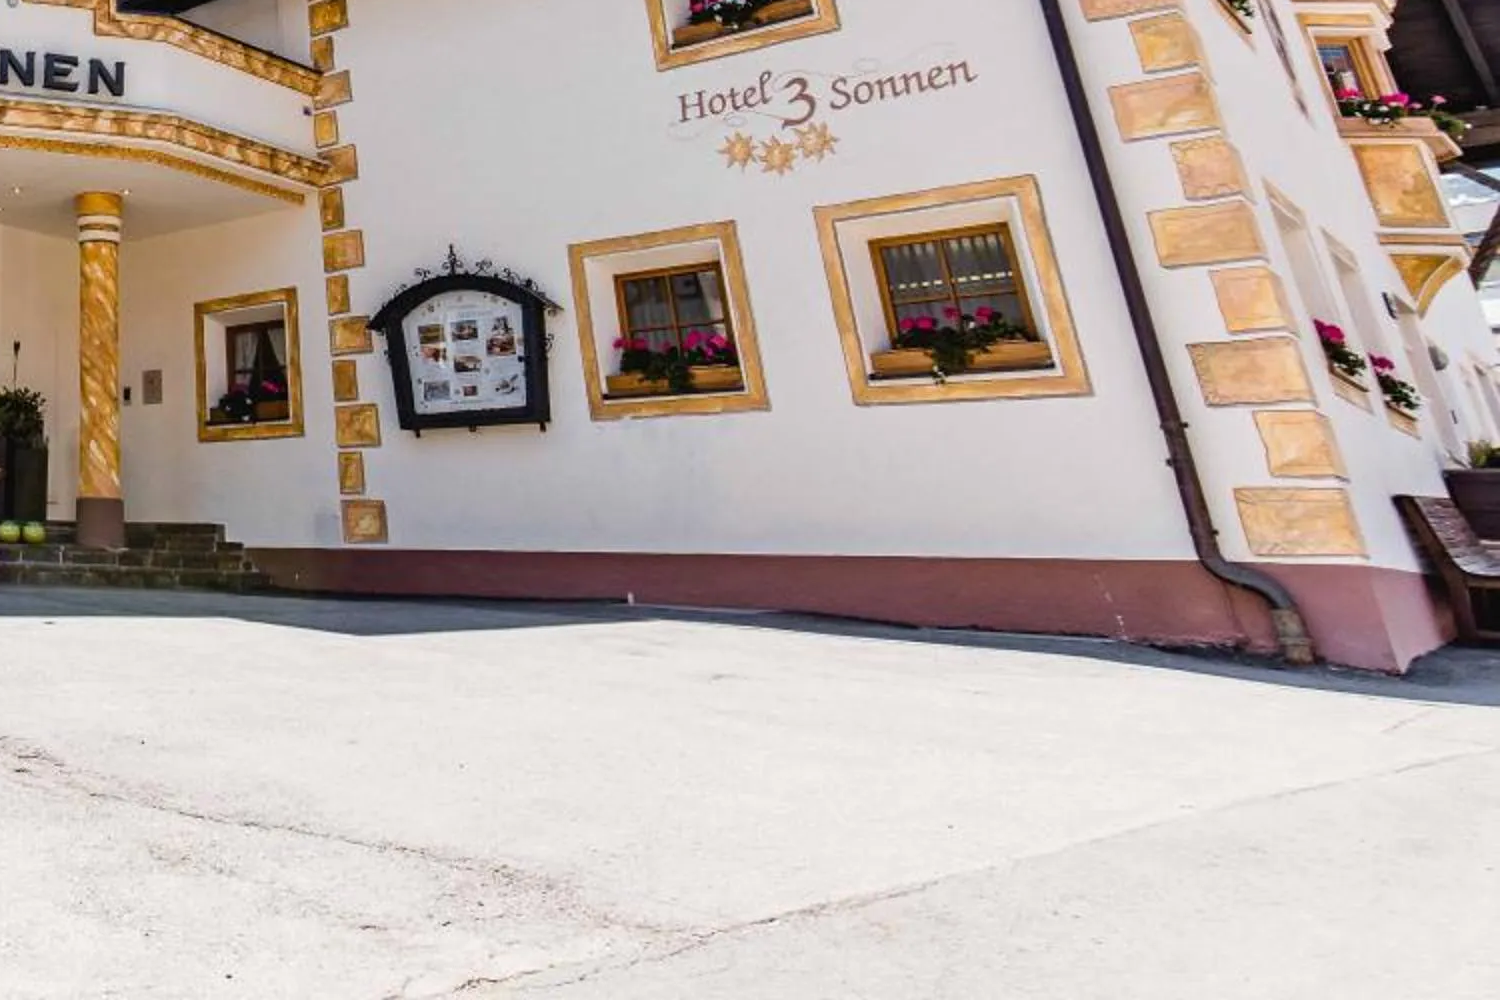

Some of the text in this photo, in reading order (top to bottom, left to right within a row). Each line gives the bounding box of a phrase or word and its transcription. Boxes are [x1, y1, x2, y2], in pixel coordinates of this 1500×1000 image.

[678, 61, 977, 129] Hotel 3 Sonnen
